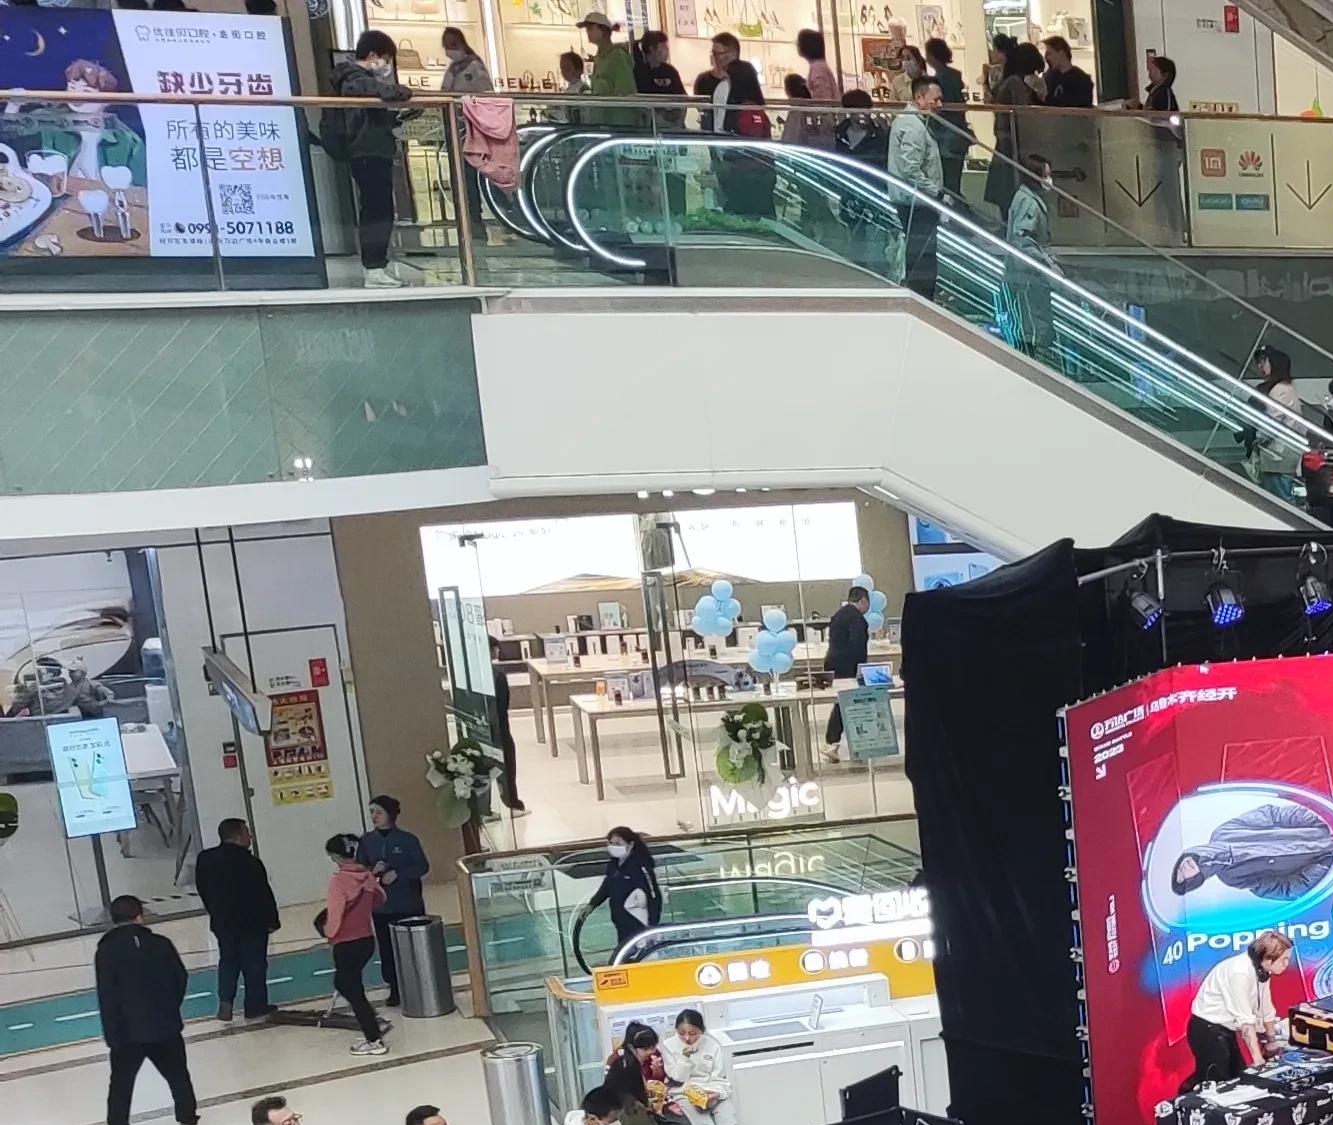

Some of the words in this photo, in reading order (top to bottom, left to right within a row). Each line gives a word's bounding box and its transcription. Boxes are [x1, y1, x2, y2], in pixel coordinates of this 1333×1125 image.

[157, 70, 274, 96] 缺少牙齿
[166, 119, 281, 141] 所有的美味
[170, 145, 286, 172] 都是空想
[188, 220, 294, 235] 099-5071188
[709, 776, 821, 820] Mgic
[1162, 939, 1184, 966] 40
[1186, 917, 1332, 954] Popping
